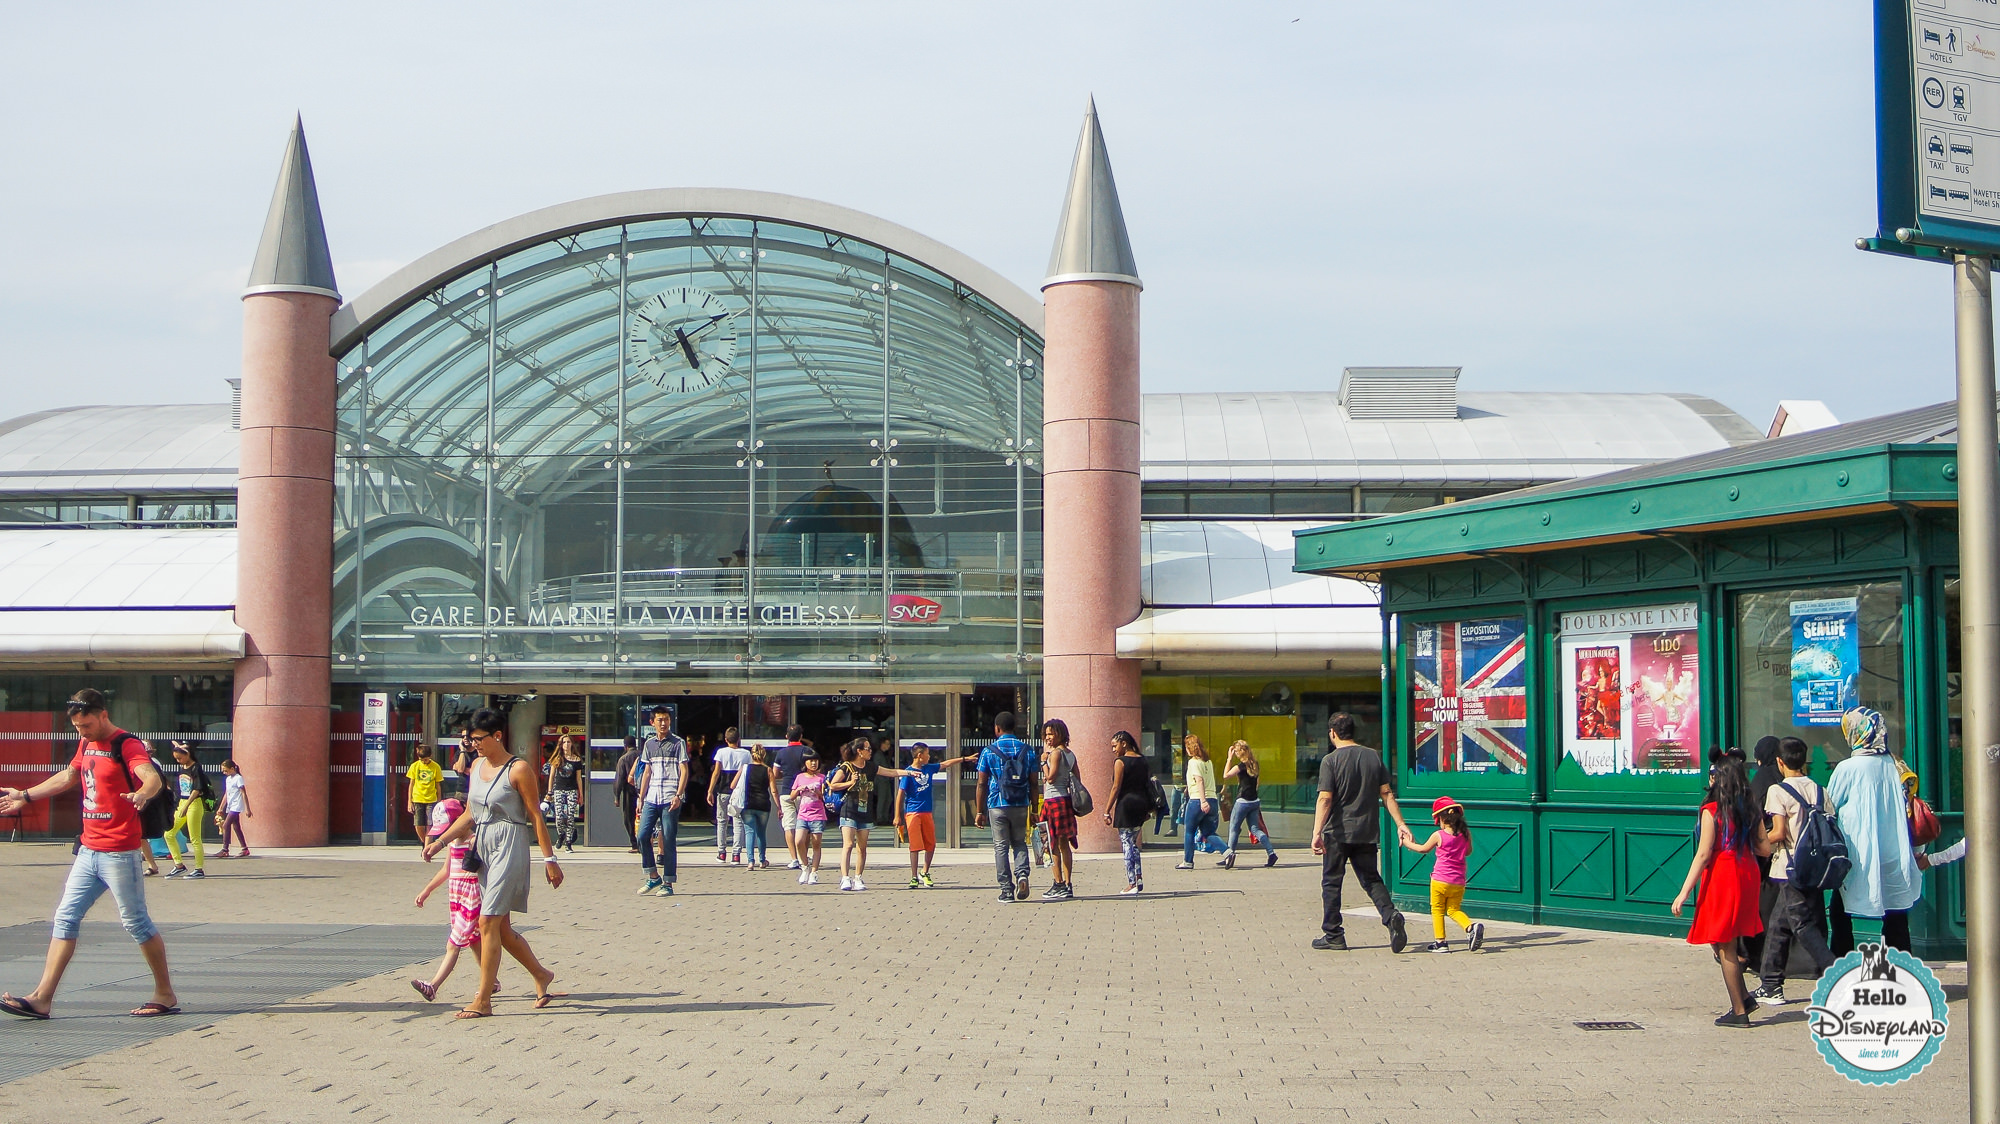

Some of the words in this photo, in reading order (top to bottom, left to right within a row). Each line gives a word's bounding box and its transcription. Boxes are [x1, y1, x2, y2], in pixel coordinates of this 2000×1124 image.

[1930, 52, 1953, 63] HÔTELS
[1926, 87, 1941, 97] RER
[1953, 113, 1968, 122] TGV
[1929, 161, 1945, 170] TAXI
[1955, 165, 1970, 174] BUS
[1973, 199, 1991, 208] Hotel
[411, 607, 475, 625] GARE
[488, 607, 515, 625] DE
[528, 607, 615, 625] MARNE
[629, 607, 652, 625] LA
[761, 606, 857, 625] CHESSY
[890, 605, 938, 620] SNCF
[1562, 610, 1654, 630] TOURISME
[1461, 625, 1500, 636] EXPOSITION
[1653, 638, 1680, 652] LIDO
[1578, 649, 1597, 660] MOULIN
[1597, 648, 1617, 659] ROUGE
[831, 695, 862, 703] CHESSY
[1434, 697, 1458, 709] JOIN
[1433, 710, 1459, 722] NOW!
